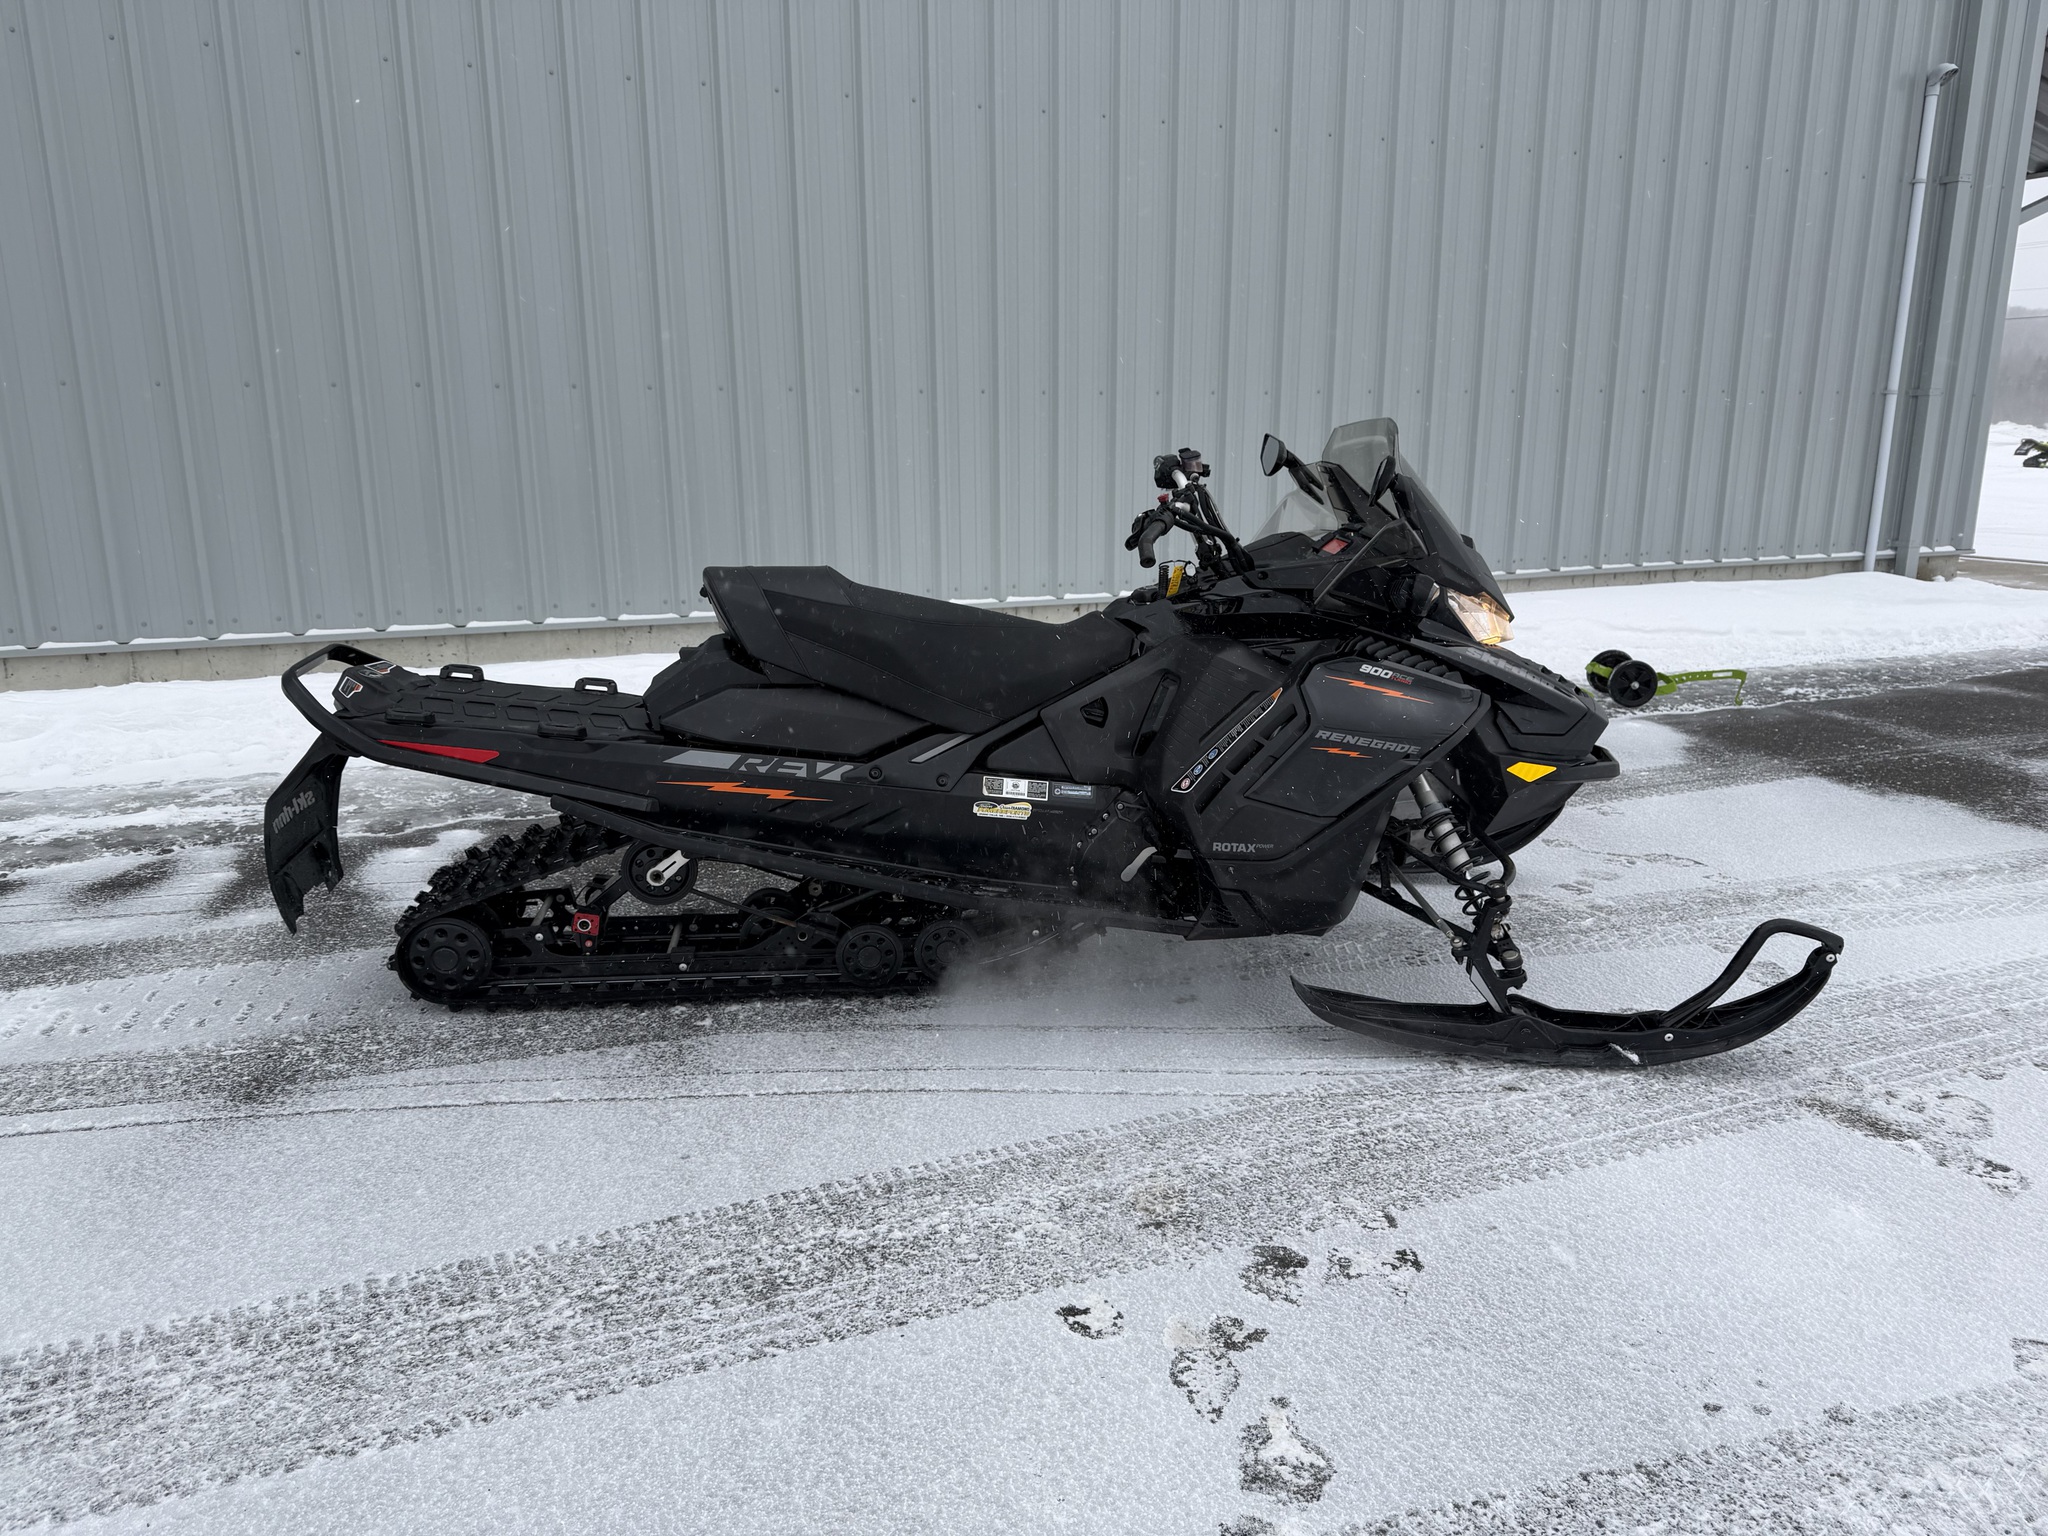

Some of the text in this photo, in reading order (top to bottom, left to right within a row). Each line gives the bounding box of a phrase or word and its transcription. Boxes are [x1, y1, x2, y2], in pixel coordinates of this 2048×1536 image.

[1359, 664, 1415, 681] 900 ACE
[1314, 730, 1422, 755] RENEGADE
[1212, 842, 1256, 853] ROTAX
